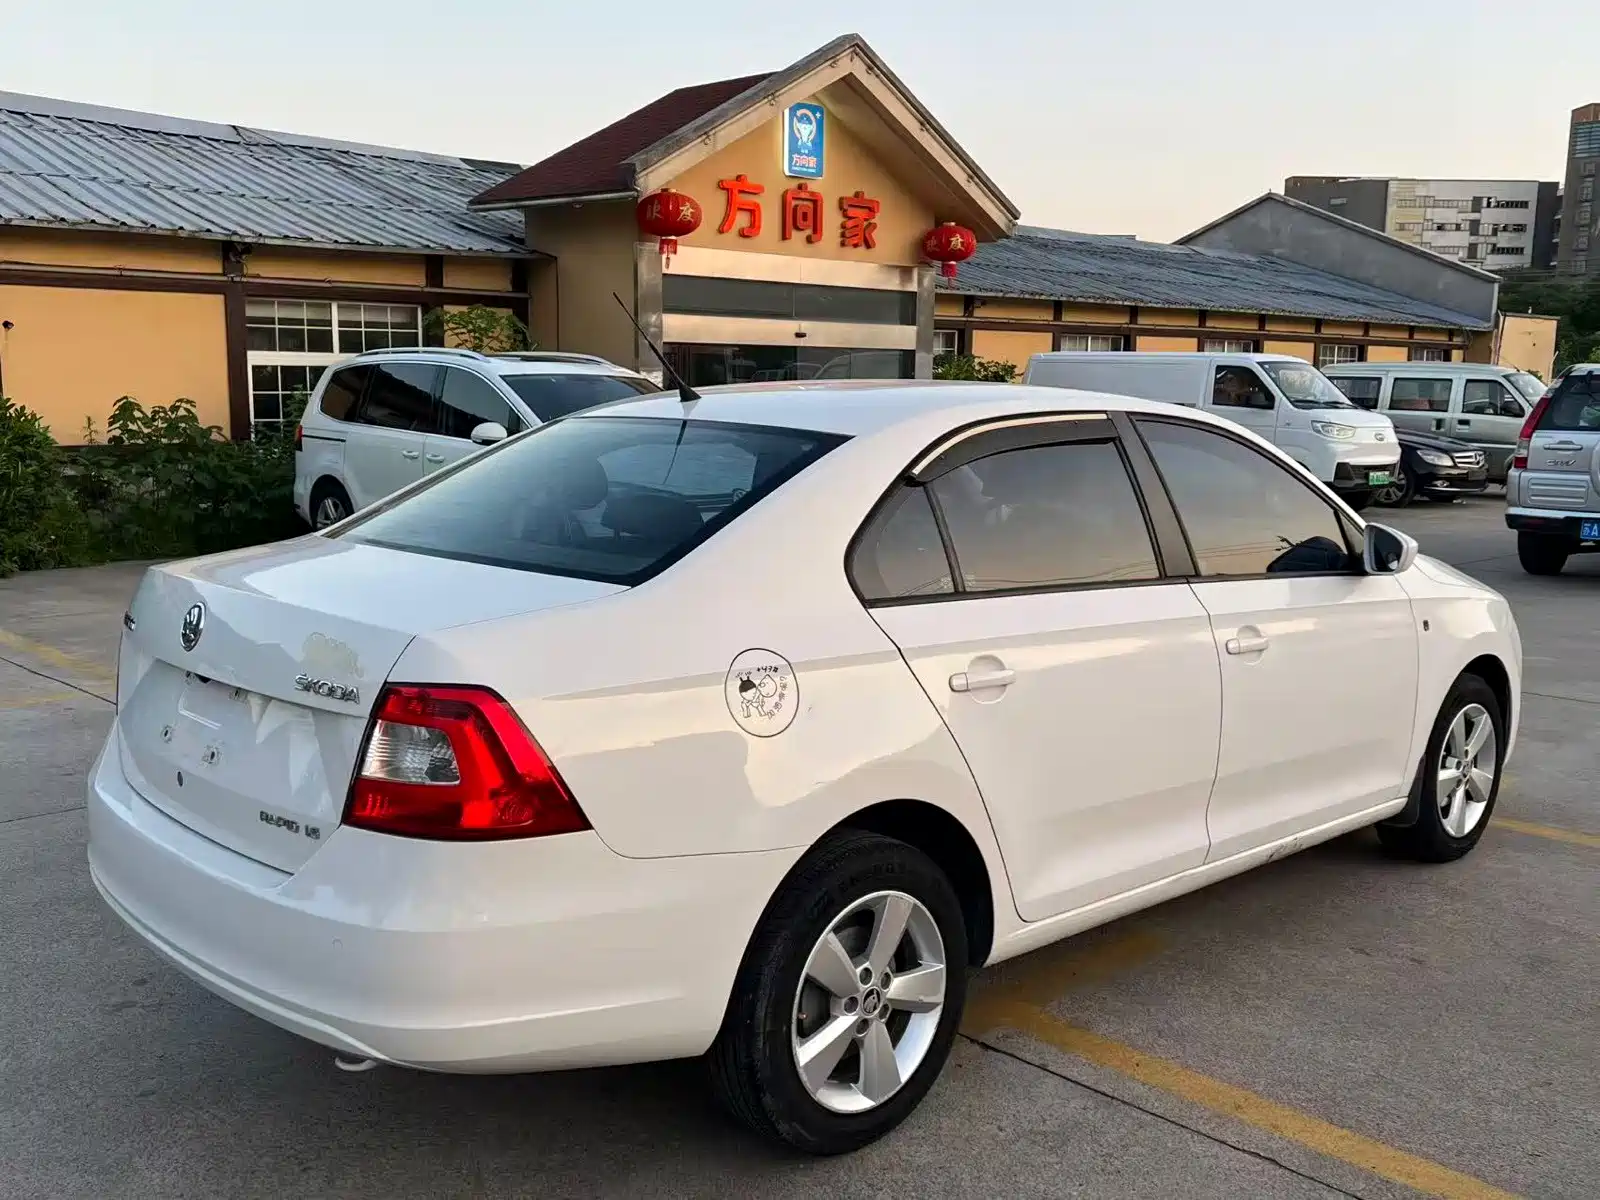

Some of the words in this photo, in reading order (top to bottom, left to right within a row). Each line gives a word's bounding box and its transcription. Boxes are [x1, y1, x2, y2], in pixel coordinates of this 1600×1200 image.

[718, 174, 880, 249] 方向家
[260, 810, 300, 833] RAPID
